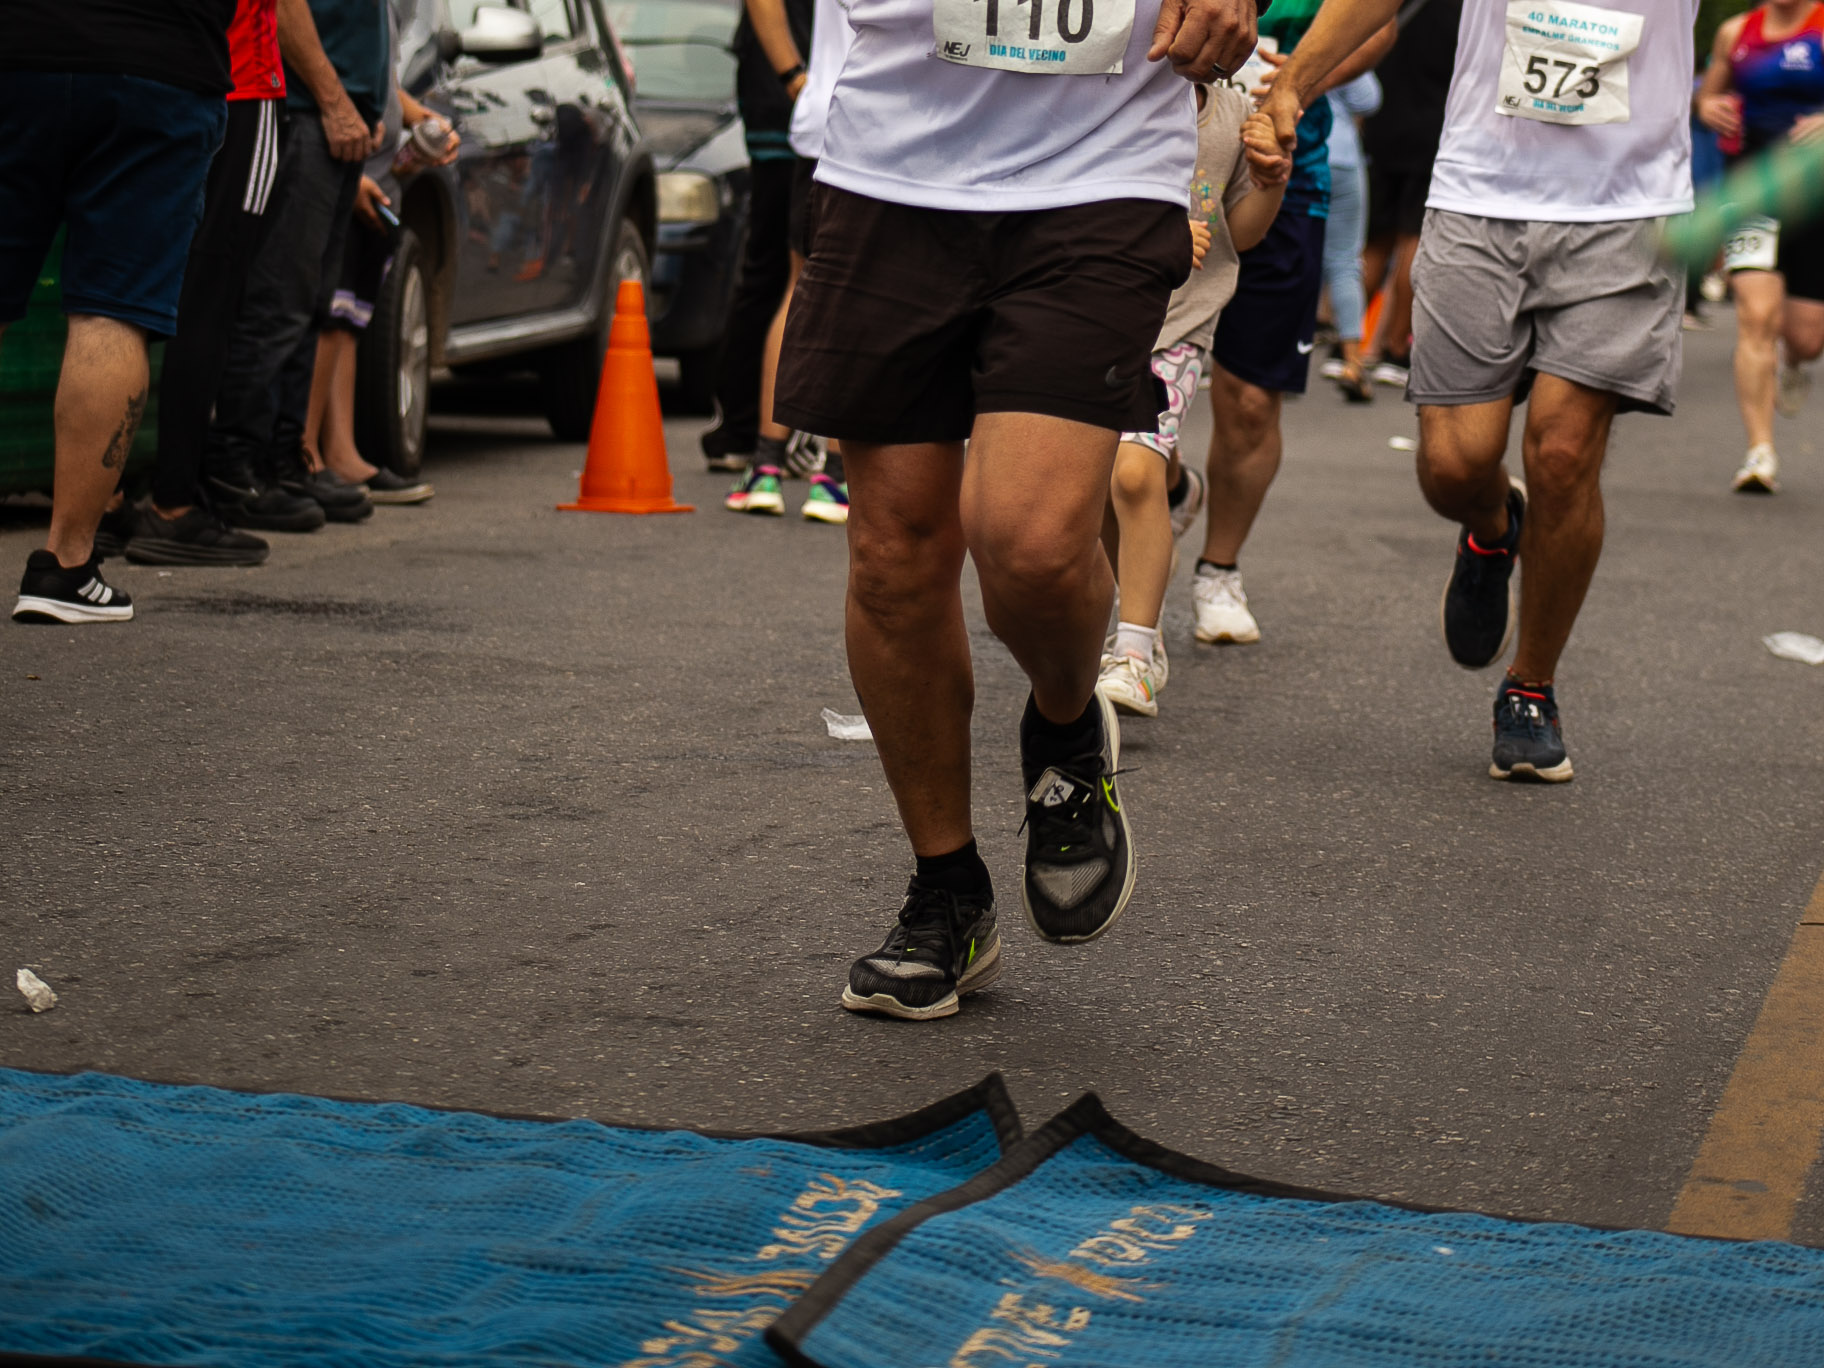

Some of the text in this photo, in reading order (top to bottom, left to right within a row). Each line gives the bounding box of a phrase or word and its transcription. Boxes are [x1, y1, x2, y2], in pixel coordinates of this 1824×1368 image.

[1528, 11, 1619, 36] 40 MARATON
[943, 41, 971, 57] NEJ
[989, 44, 1067, 62] DIA DEL VECINO
[1523, 55, 1601, 99] 573
